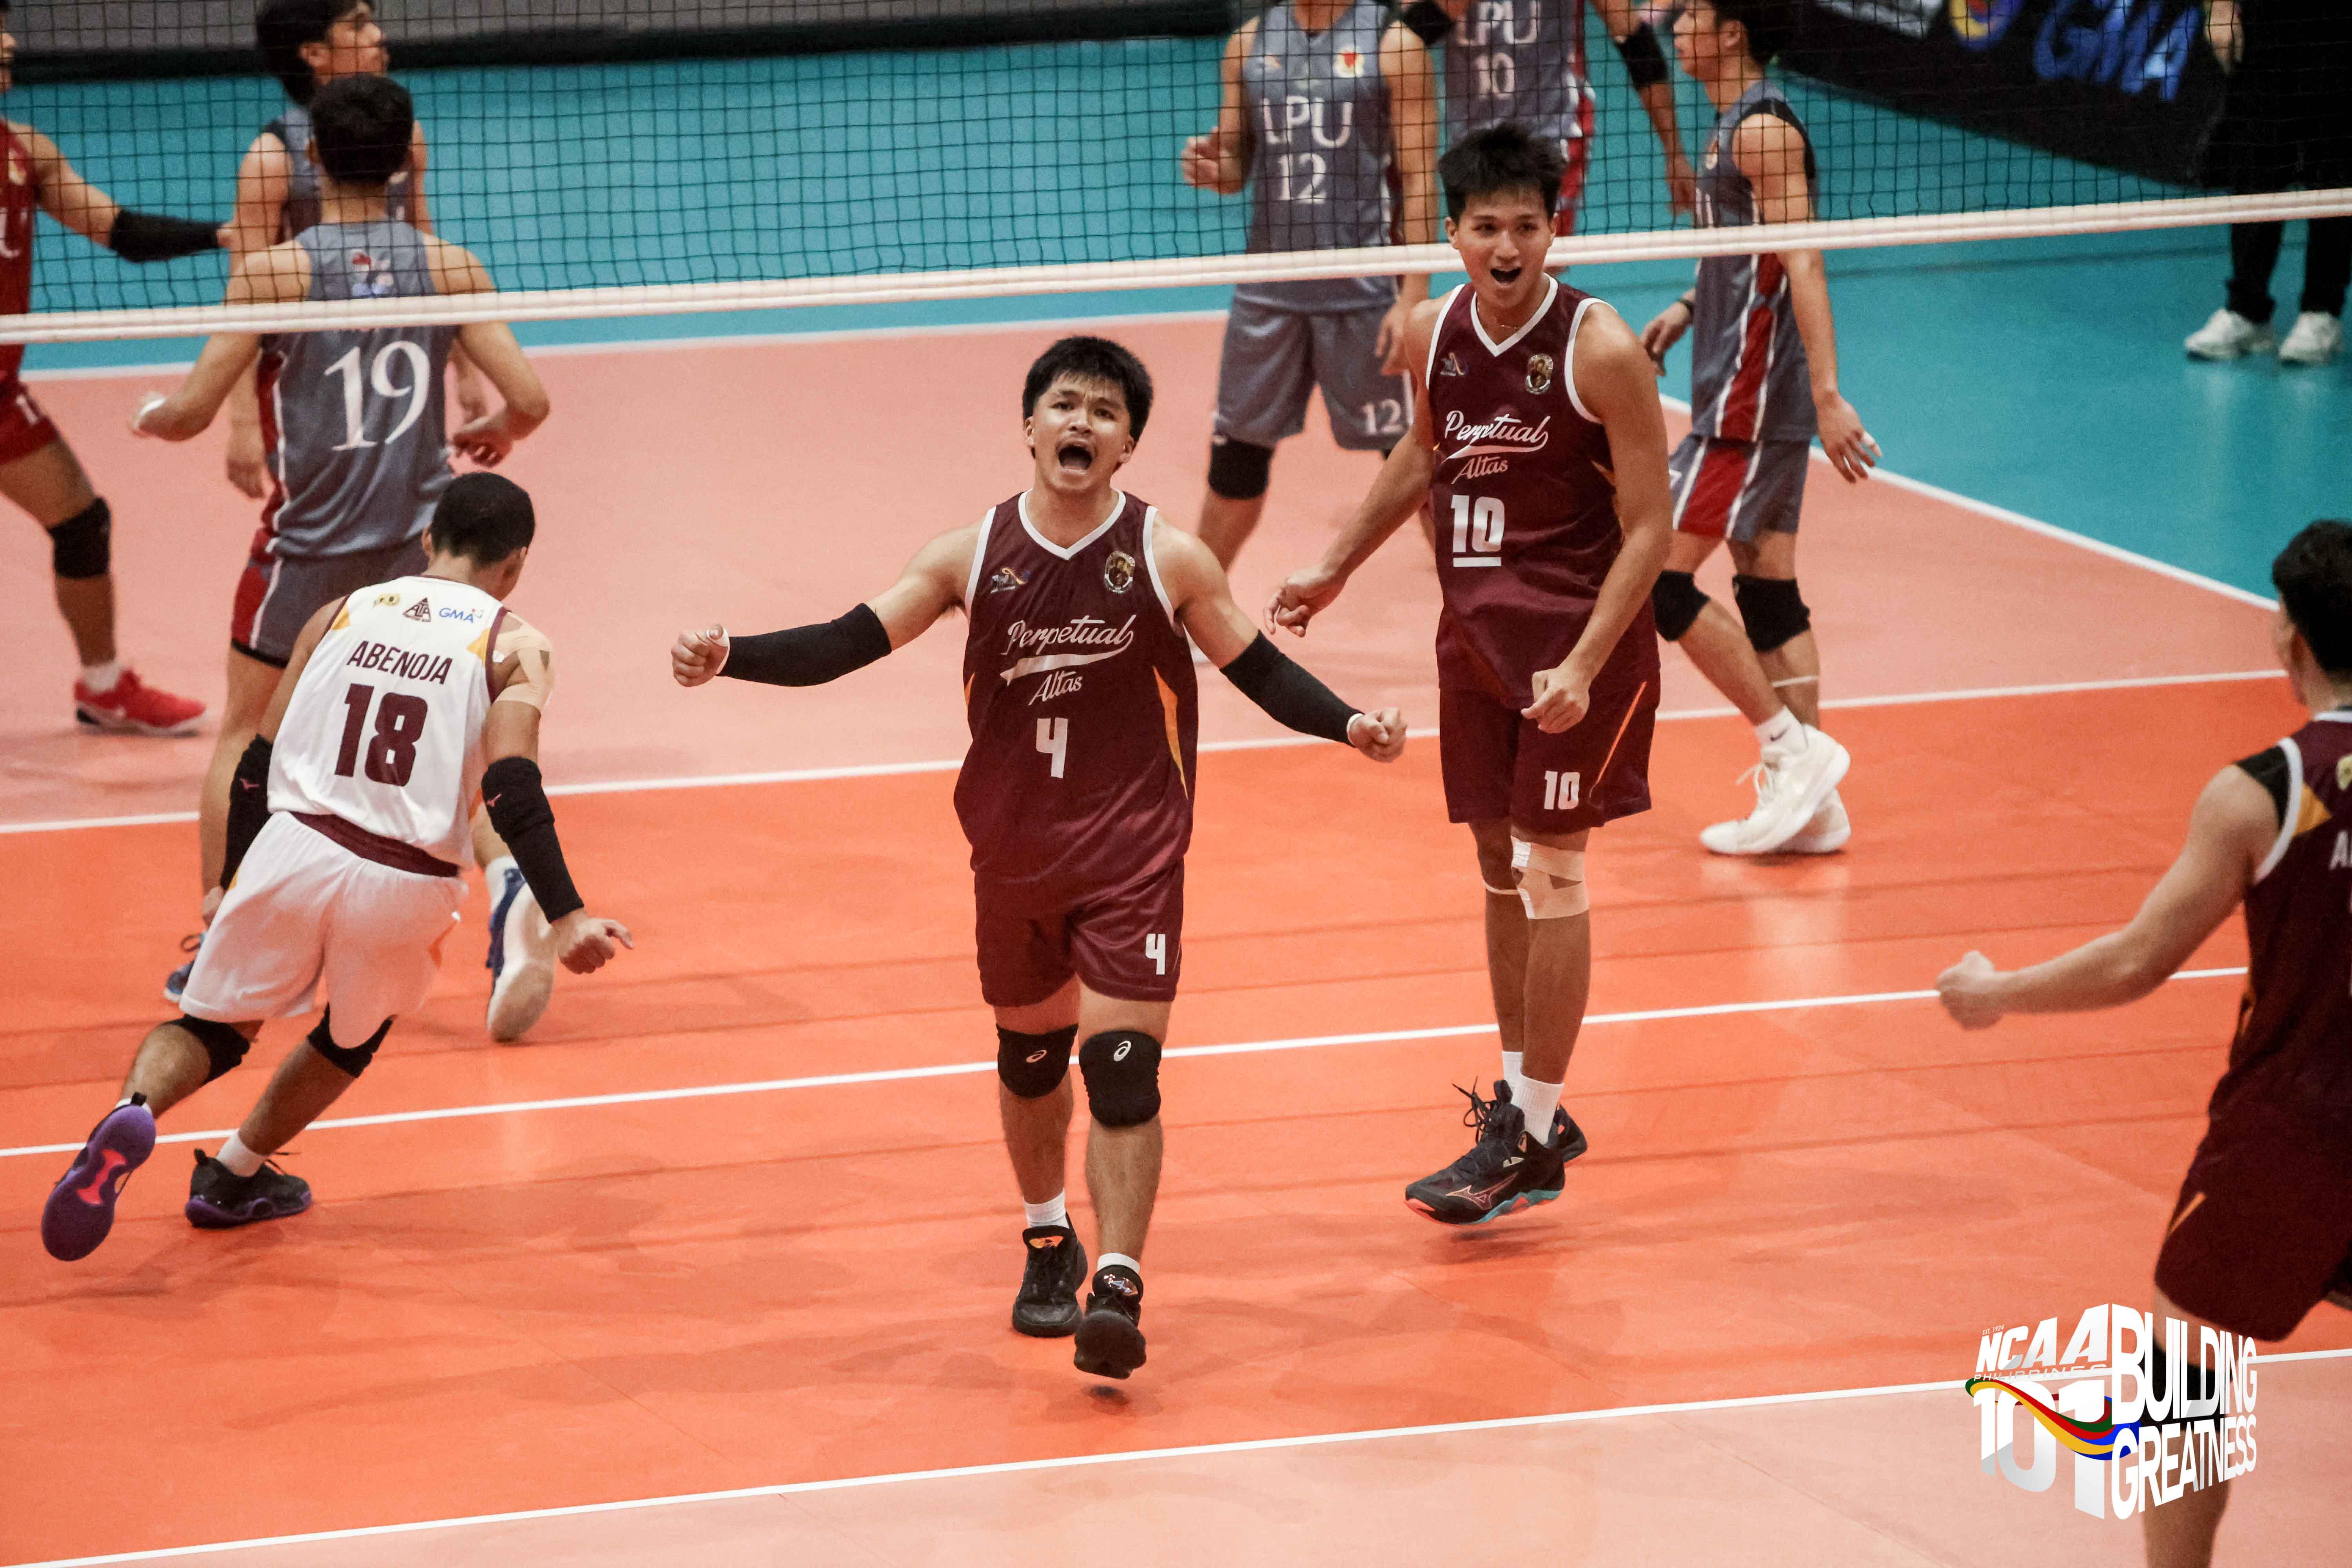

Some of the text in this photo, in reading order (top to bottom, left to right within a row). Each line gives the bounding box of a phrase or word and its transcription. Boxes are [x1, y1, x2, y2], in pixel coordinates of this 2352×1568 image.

[1475, 53, 1515, 99] 10
[1261, 95, 1354, 148] LPU
[1278, 153, 1327, 204] 12
[324, 340, 430, 451] 19
[1362, 399, 1403, 434] 12
[1445, 410, 1550, 447] Perpetual
[1451, 456, 1508, 485] Altas
[1451, 494, 1504, 553] 10
[439, 608, 474, 622] GMA
[1001, 615, 1137, 655] Perpetual
[346, 641, 453, 685] ABENOJA
[1029, 671, 1083, 706] Altas
[334, 683, 428, 787] 18
[1036, 717, 1069, 779] 4
[1544, 770, 1580, 810] 10
[1145, 933, 1165, 975] 4
